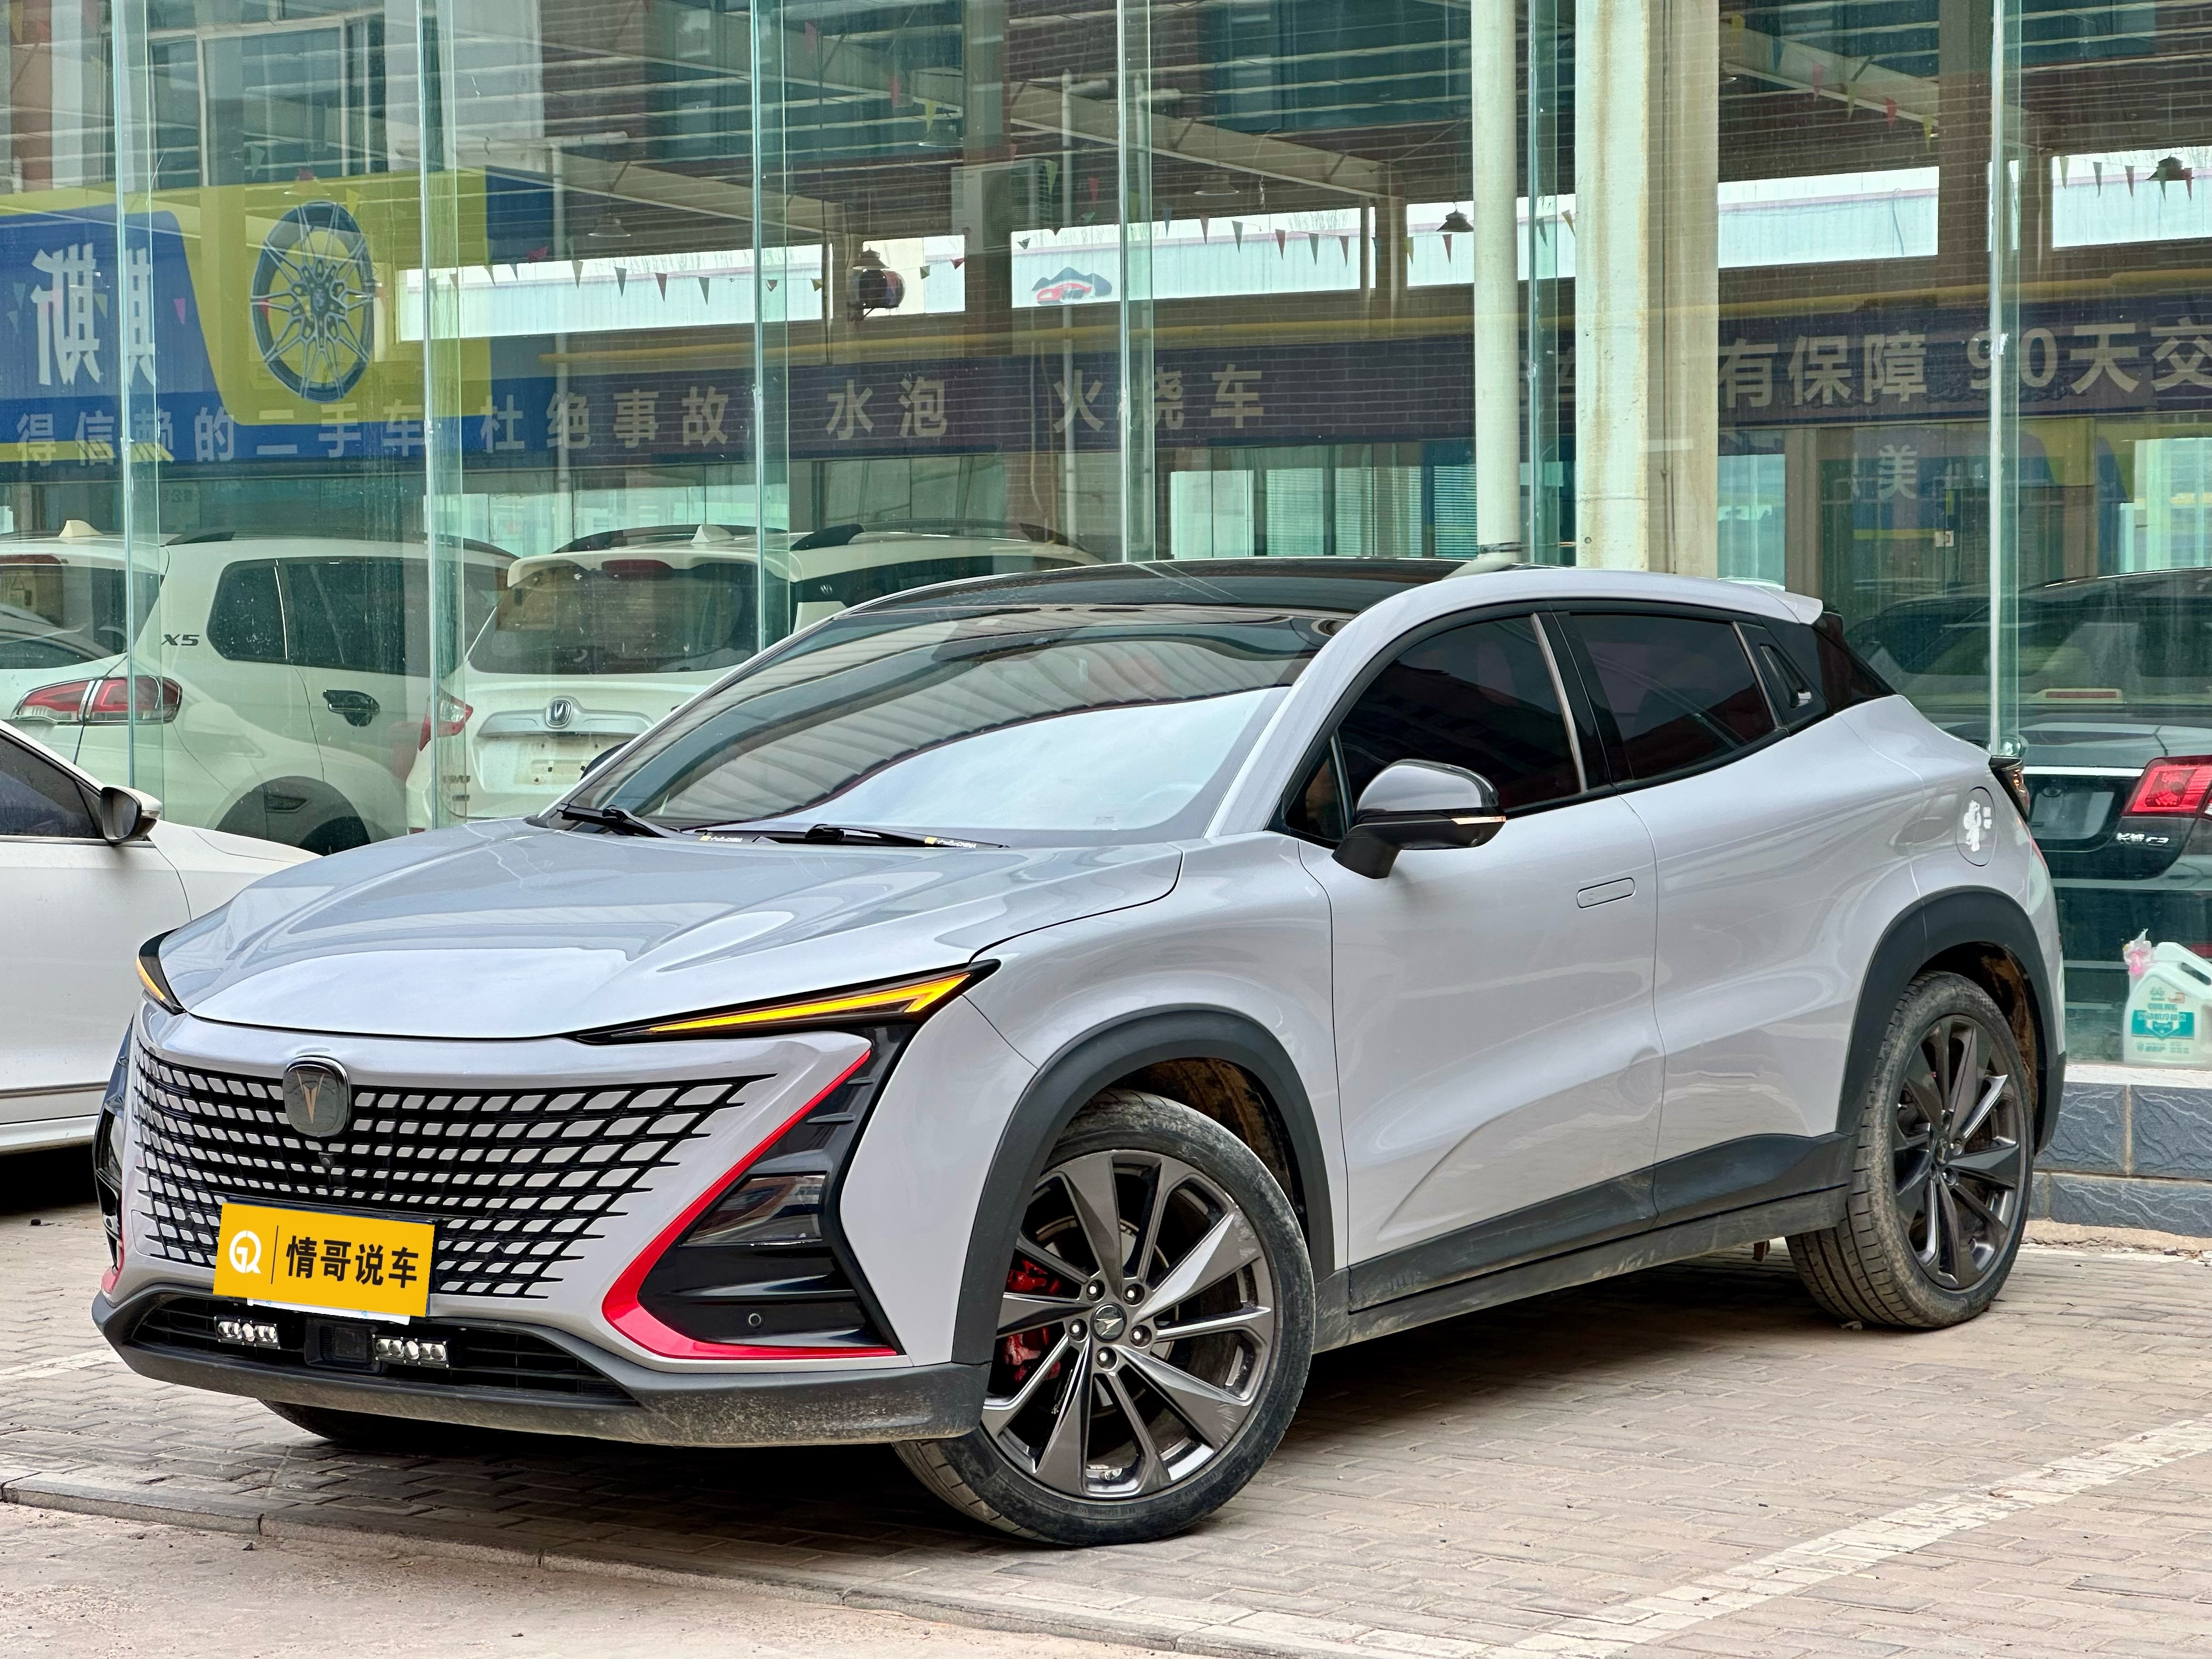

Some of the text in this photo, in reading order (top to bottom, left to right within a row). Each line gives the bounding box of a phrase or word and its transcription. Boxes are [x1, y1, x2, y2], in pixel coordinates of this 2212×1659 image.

[480, 386, 729, 454] 杜绝事故
[826, 376, 948, 441] 水泡
[1718, 330, 1928, 409] 有保障
[161, 633, 199, 646] X5
